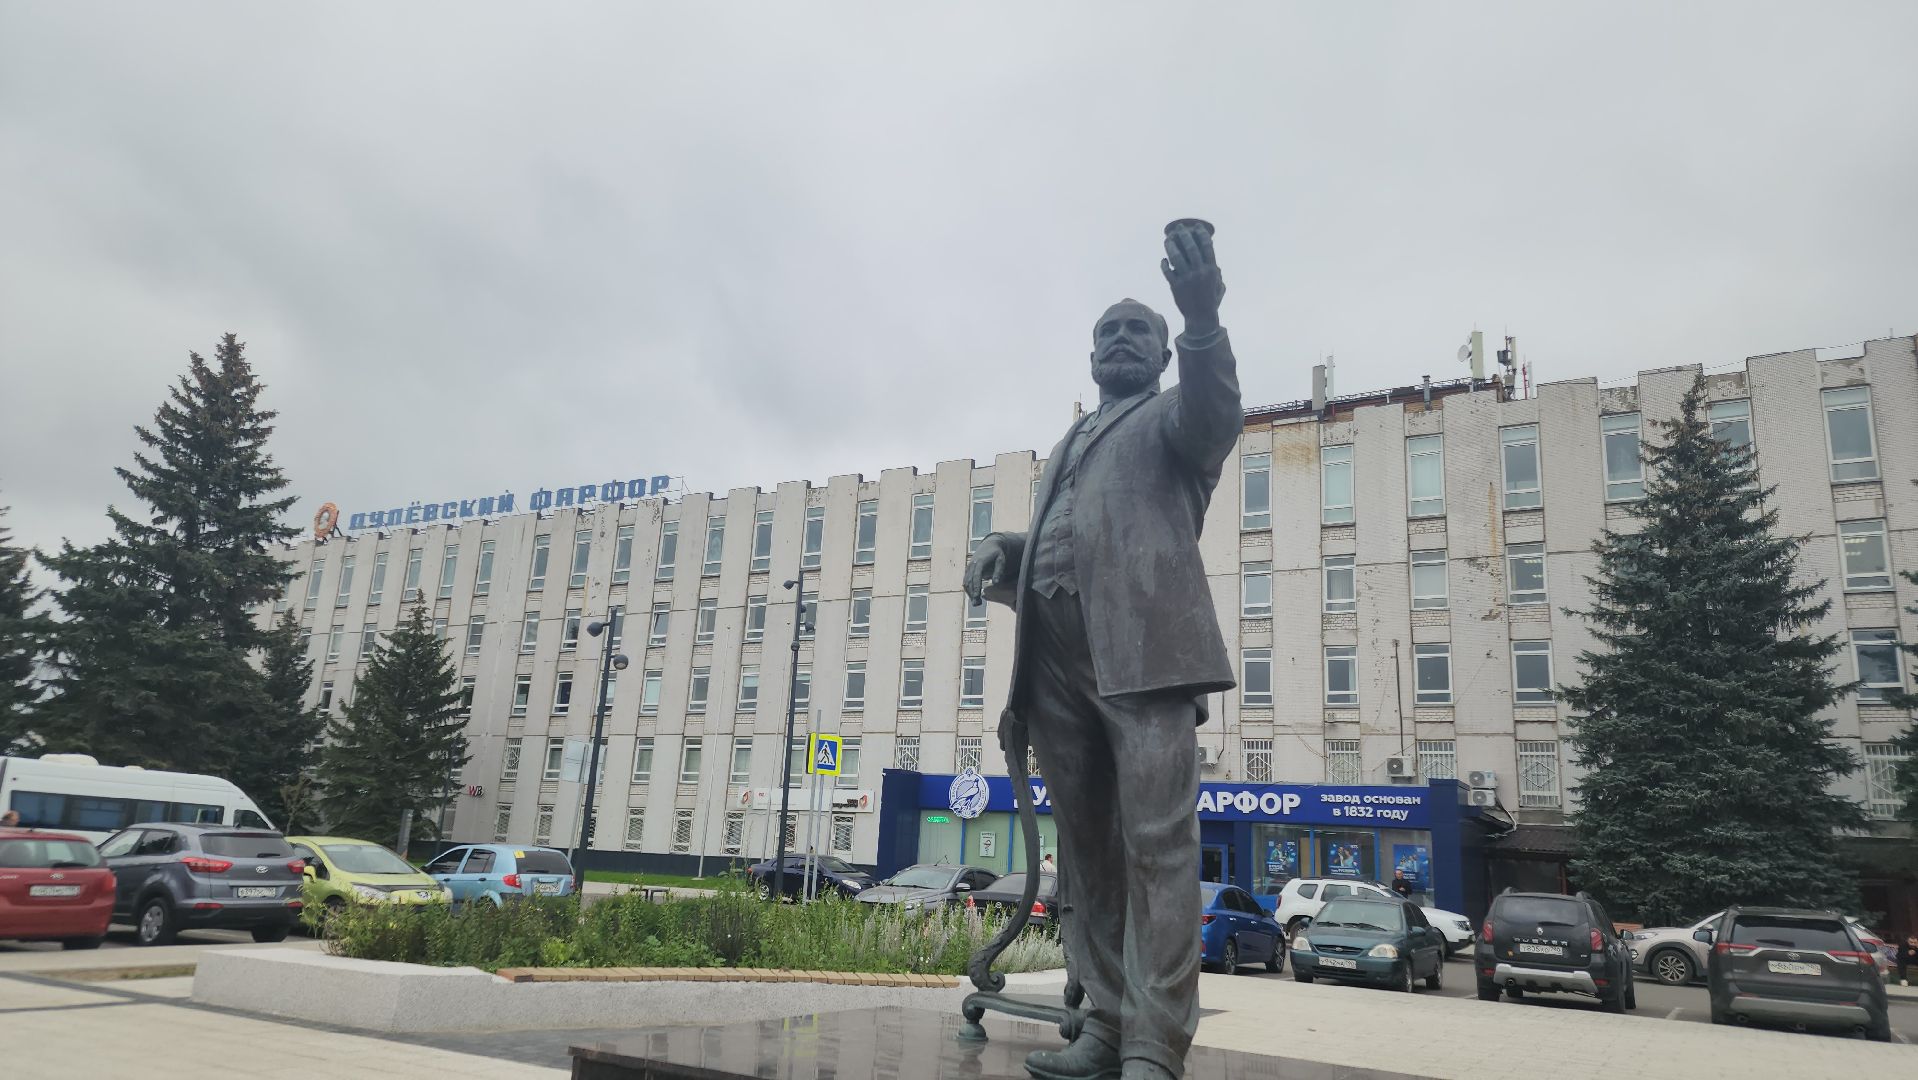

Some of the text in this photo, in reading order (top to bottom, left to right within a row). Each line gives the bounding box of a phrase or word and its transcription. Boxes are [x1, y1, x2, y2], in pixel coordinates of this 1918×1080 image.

[349, 475, 670, 530] ДУЛЁВСКИЙ ФАРФОР
[1196, 790, 1301, 815] АРФОР
[1343, 806, 1374, 818] 1832
